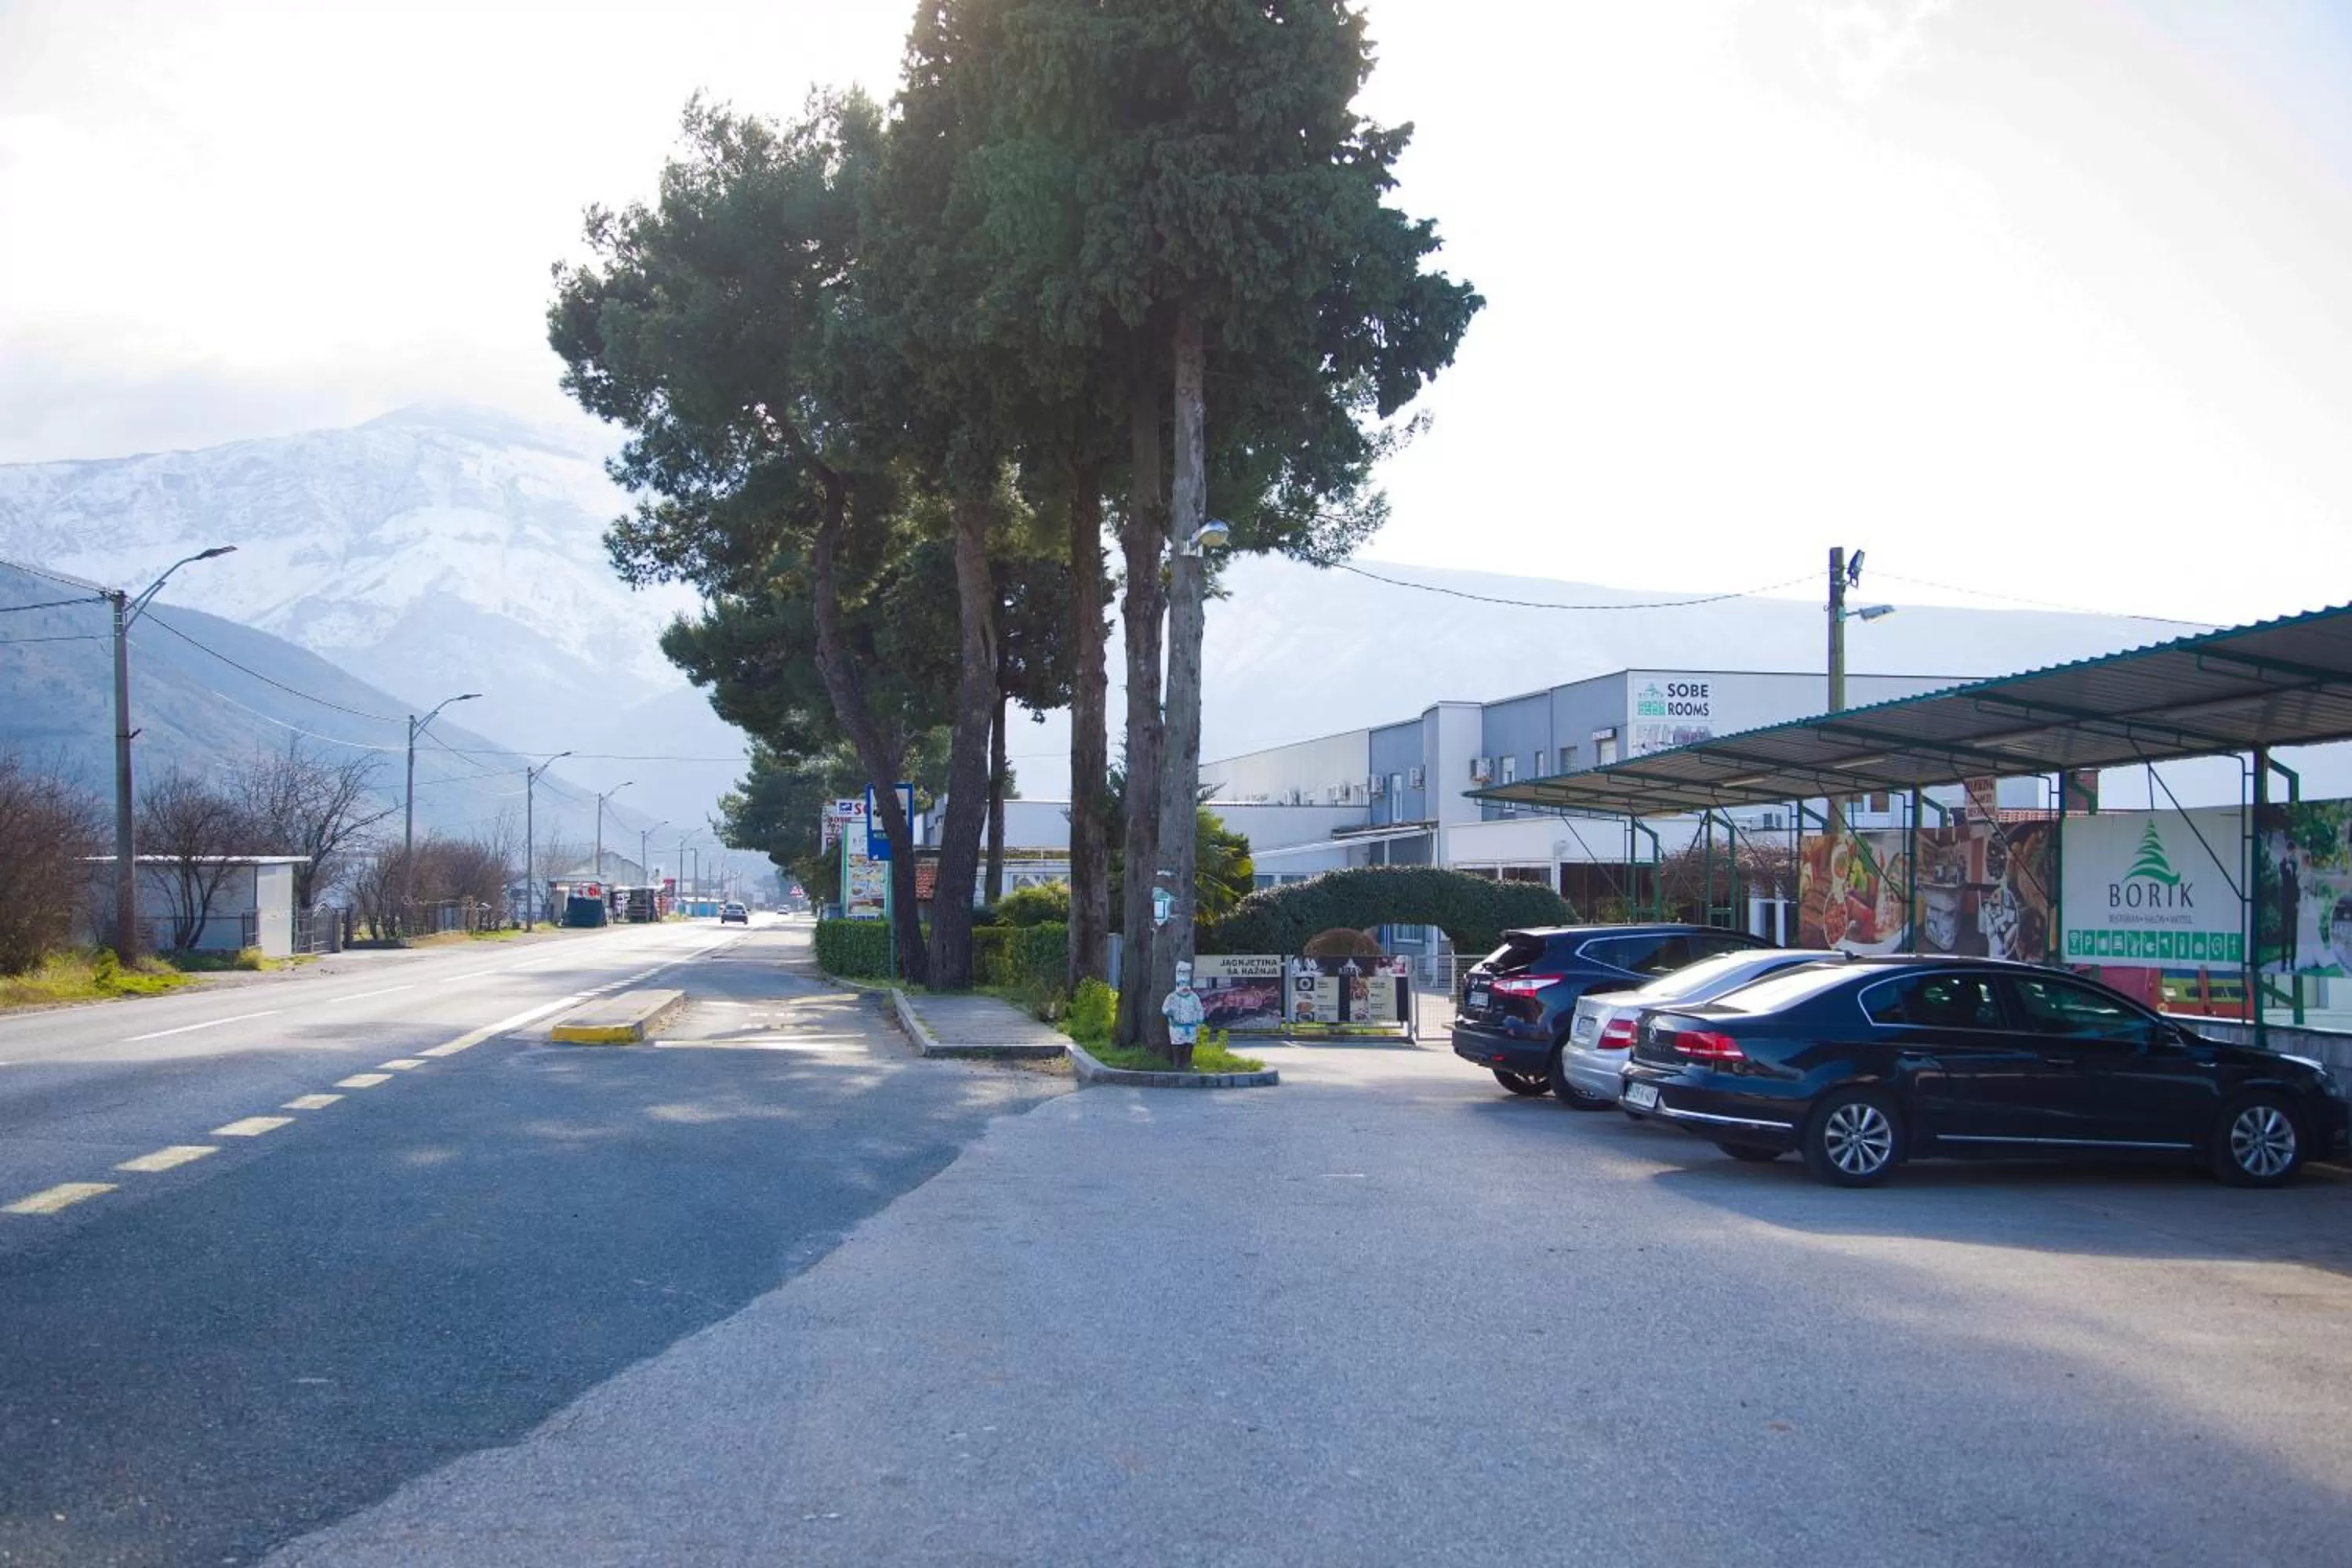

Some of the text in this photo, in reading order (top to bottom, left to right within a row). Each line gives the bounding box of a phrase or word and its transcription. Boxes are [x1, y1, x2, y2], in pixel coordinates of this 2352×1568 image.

[1668, 683, 1709, 698] SOBE
[1668, 702, 1710, 716] ROOMS
[2109, 883, 2194, 908] BORIK
